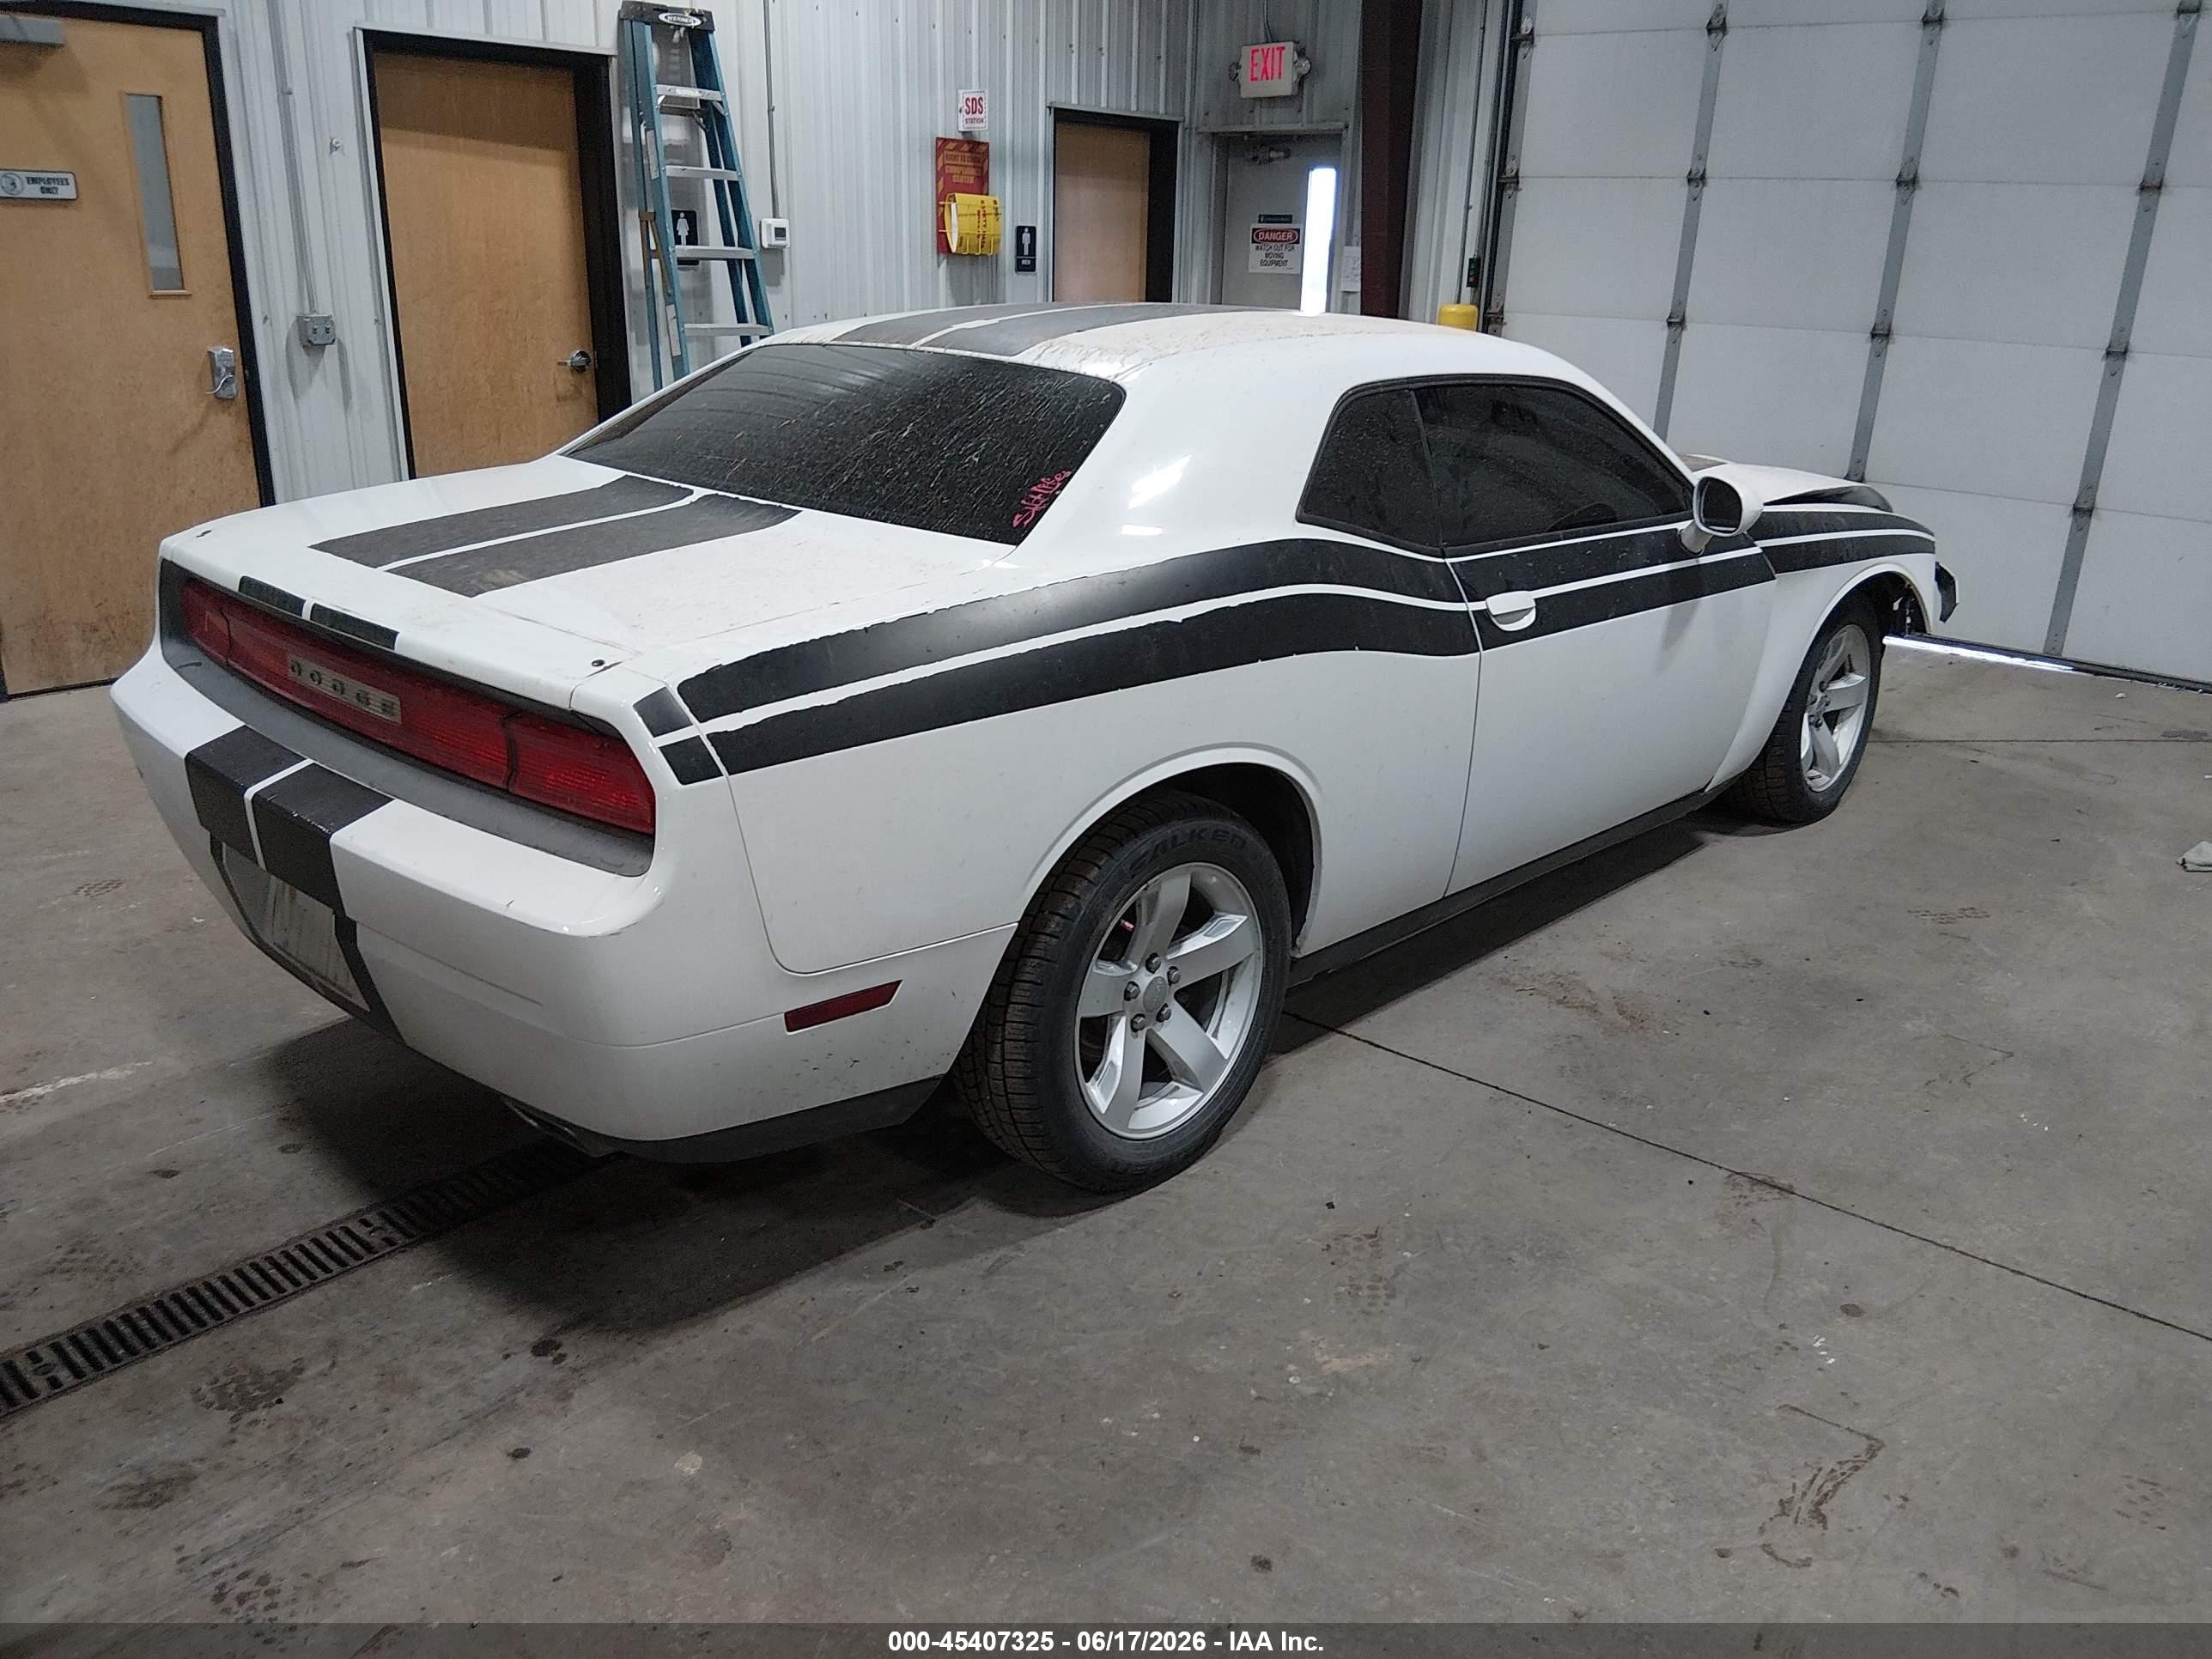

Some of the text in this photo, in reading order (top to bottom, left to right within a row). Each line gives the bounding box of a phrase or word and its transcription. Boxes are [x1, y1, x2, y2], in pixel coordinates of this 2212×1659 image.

[1250, 46, 1285, 82] EXIT
[965, 97, 984, 115] SDS
[1258, 231, 1292, 241] DANGER
